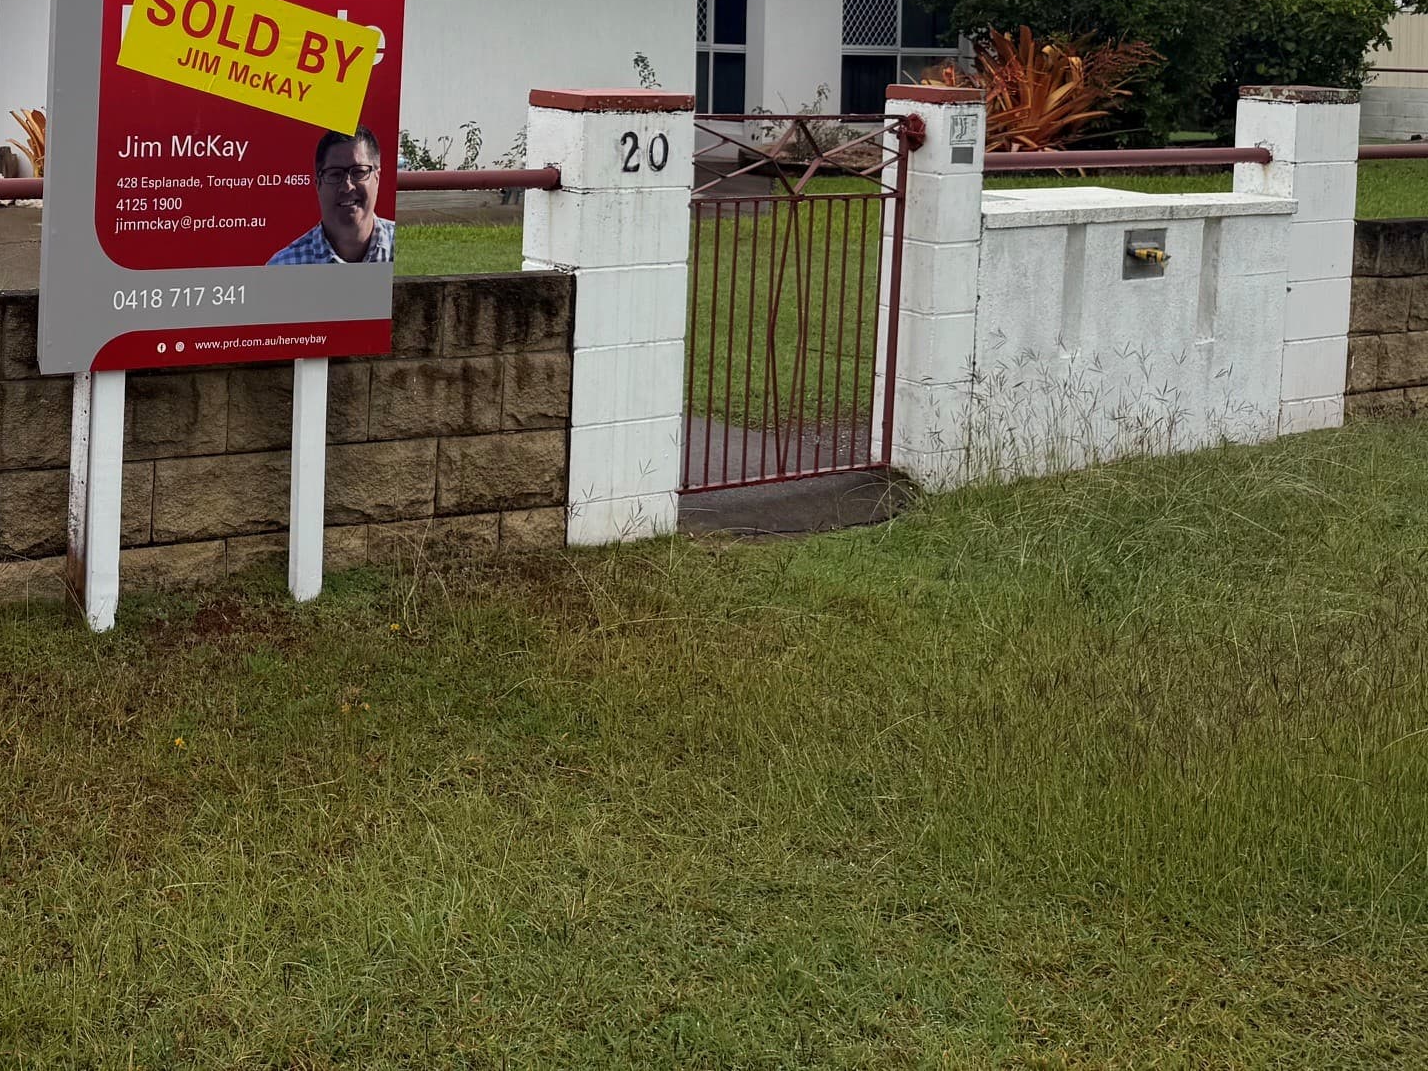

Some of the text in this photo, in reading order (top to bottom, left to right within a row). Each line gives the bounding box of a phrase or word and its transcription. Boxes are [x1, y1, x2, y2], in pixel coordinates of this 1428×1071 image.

[296, 30, 364, 83] BY
[177, 47, 312, 102] JIM McKAY
[118, 134, 249, 162] Jim McKay
[620, 131, 669, 172] 20
[116, 174, 311, 191] 428 Esplanade, Torquay QLD 4655
[115, 197, 183, 211] 4125 1900
[115, 215, 267, 234] jimmckay@prd.com.au
[113, 285, 246, 310] 0418 717 341
[195, 334, 327, 350] www.prd.com.au/herveybay
